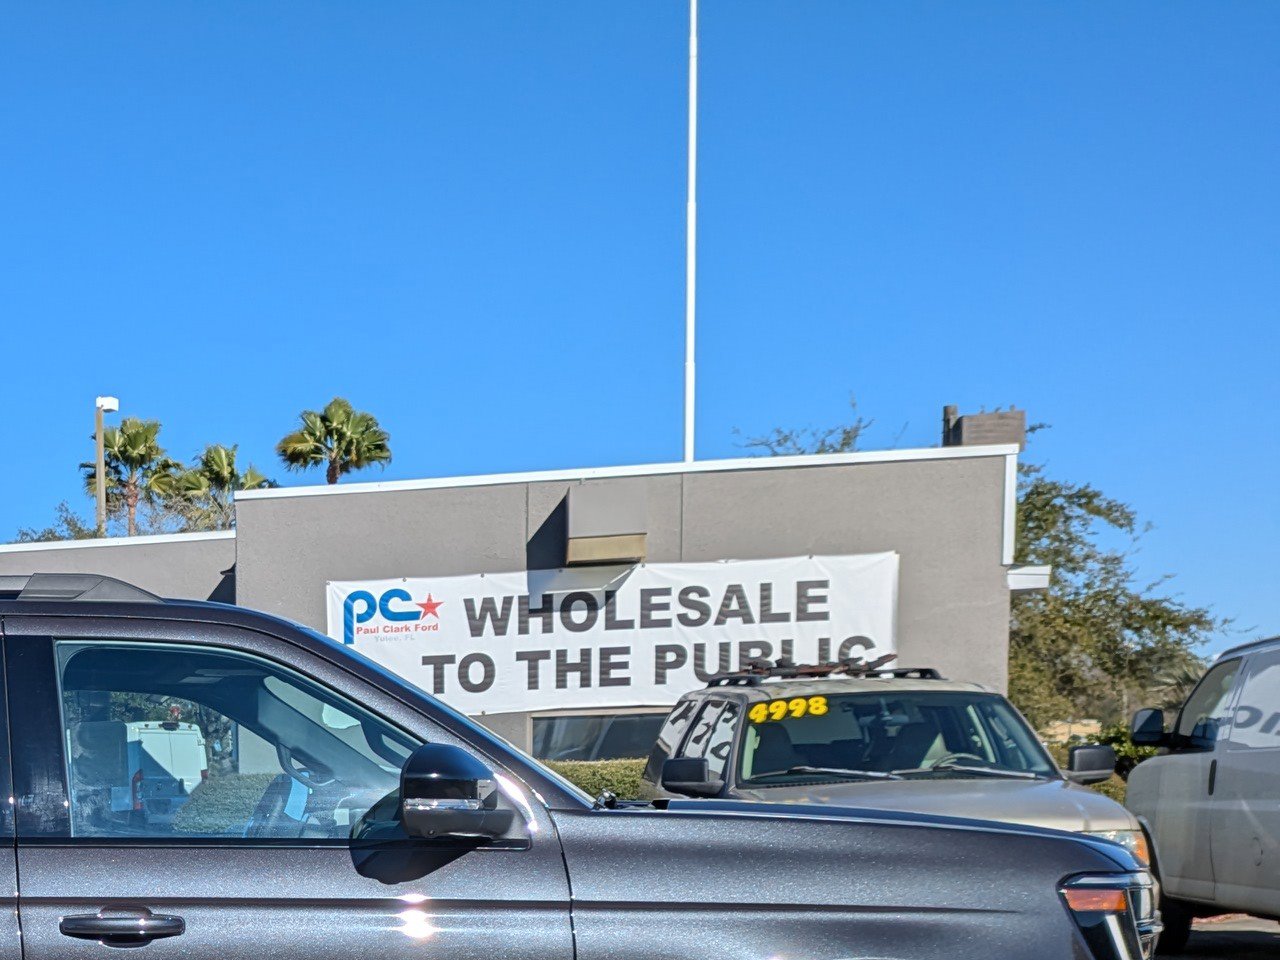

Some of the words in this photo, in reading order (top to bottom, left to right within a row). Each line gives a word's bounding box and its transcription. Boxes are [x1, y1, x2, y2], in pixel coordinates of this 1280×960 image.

[463, 579, 830, 638] WHOLESALE
[356, 626, 379, 635] Paul
[382, 624, 411, 634] Clark
[414, 623, 439, 632] Ford
[422, 652, 496, 695] TO
[516, 646, 631, 690] THE
[748, 696, 829, 724] 4998
